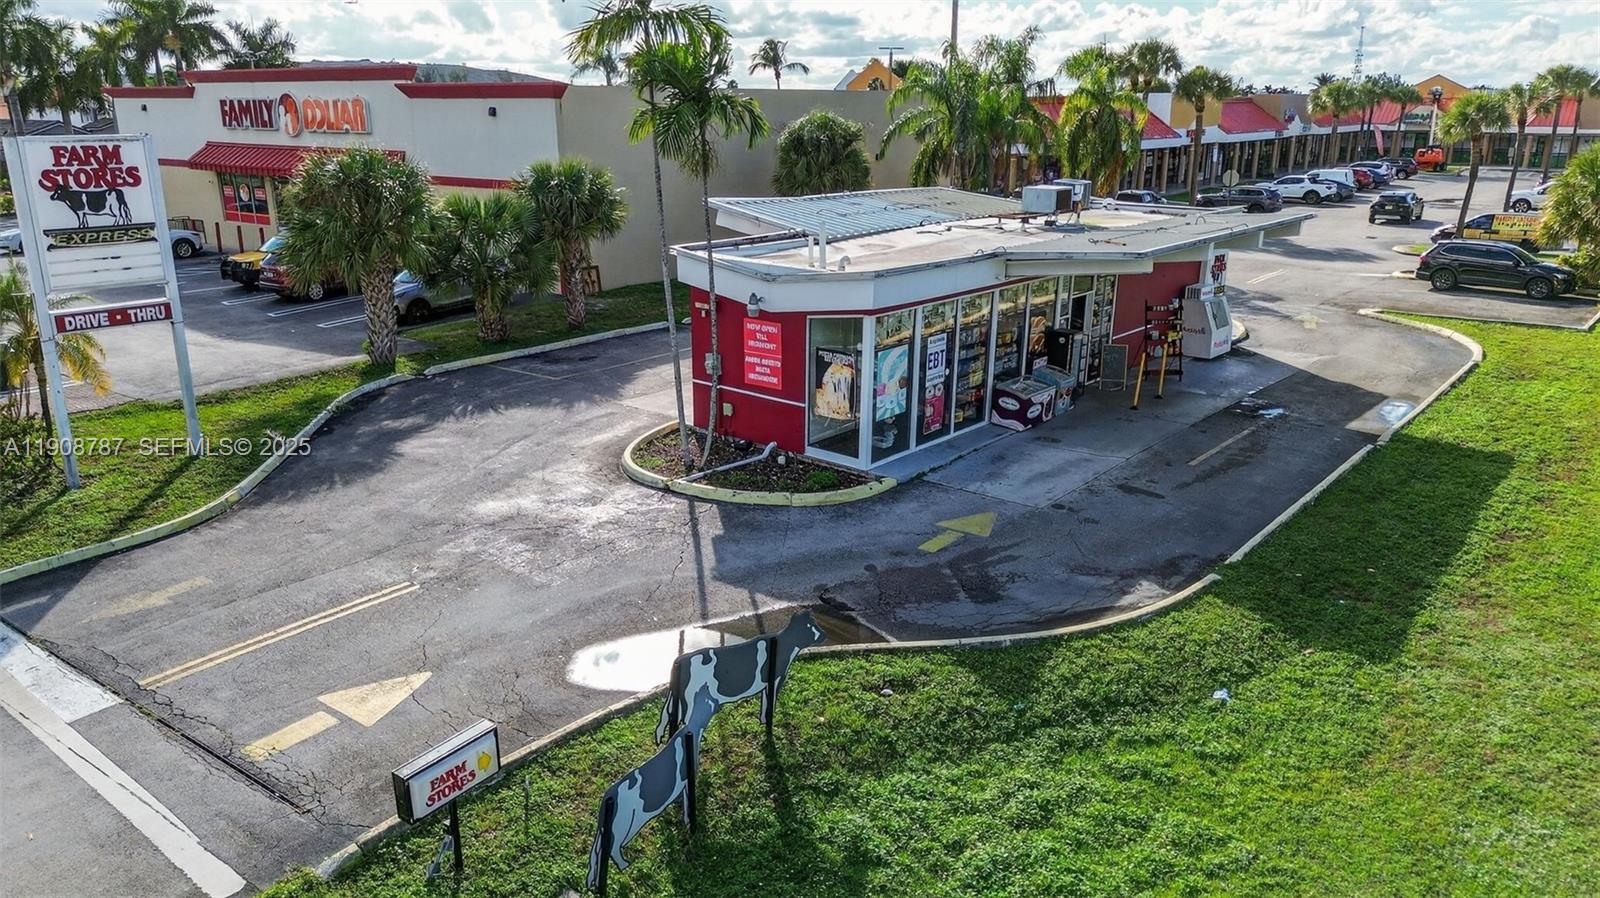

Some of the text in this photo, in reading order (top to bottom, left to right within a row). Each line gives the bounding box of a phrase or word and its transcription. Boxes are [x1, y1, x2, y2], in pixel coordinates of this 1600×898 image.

[219, 97, 369, 133] FAMILY DOLLAR
[50, 144, 124, 168] FARM
[38, 166, 142, 192] STORES
[54, 227, 153, 246] EXPRESS
[64, 305, 166, 331] DRIVE THRU
[927, 349, 945, 370] EBT
[425, 769, 477, 808] STORES
[430, 760, 467, 793] FARM
